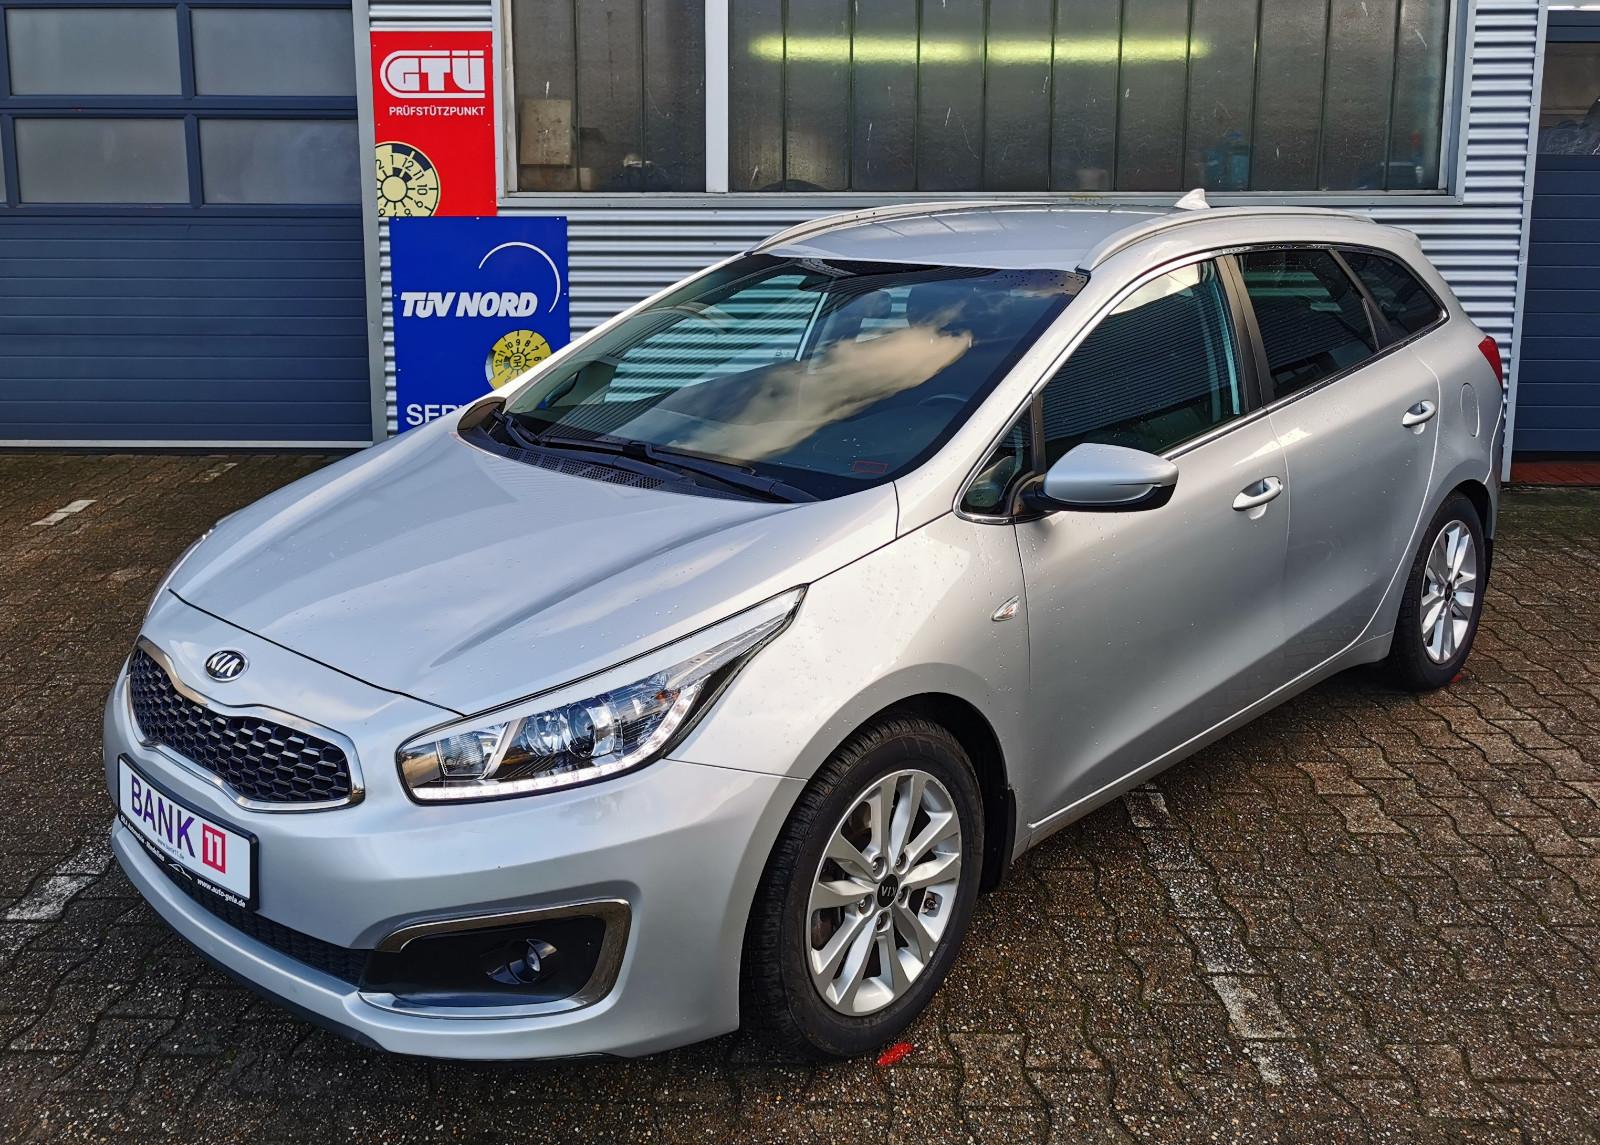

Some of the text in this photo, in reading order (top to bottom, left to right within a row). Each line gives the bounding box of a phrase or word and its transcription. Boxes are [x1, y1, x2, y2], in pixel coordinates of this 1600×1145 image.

[381, 50, 485, 97] GTÜ
[389, 104, 485, 116] PRÜFSTÜTZPUNKT
[402, 157, 414, 172] 12
[413, 169, 424, 181] 11
[417, 183, 428, 196] 10
[400, 291, 538, 319] TÜV NORD
[505, 341, 514, 350] 10
[515, 338, 521, 346] 9
[524, 339, 531, 347] 8
[207, 651, 240, 677] KIA
[131, 774, 223, 868] BANK 11
